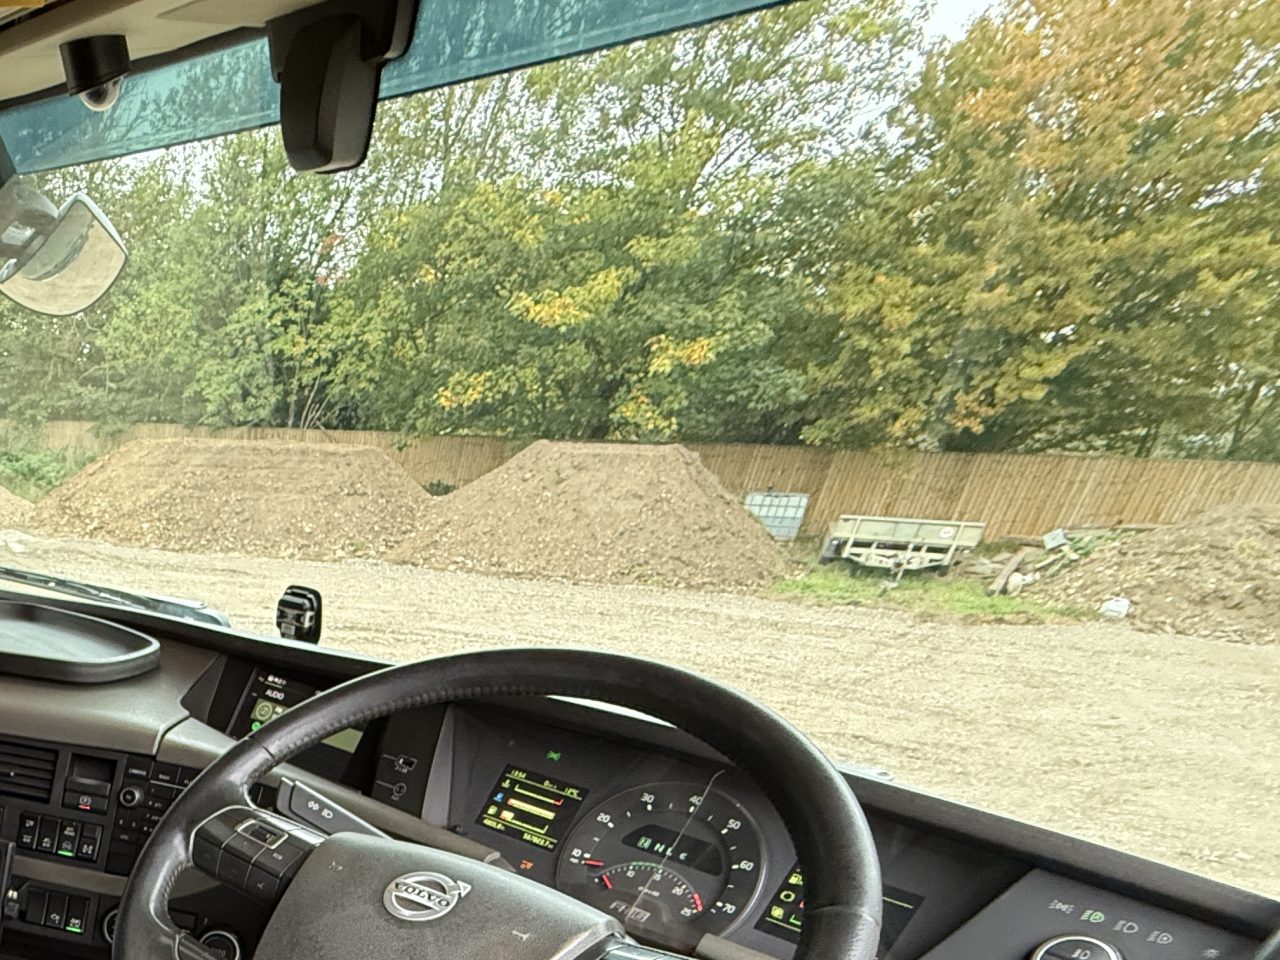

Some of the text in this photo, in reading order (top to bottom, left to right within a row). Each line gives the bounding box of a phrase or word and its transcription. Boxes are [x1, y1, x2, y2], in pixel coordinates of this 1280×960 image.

[265, 688, 285, 701] AUDIO
[641, 792, 654, 803] 30
[689, 795, 704, 806] 40
[596, 812, 611, 823] 20
[727, 819, 742, 830] 50
[571, 848, 582, 857] 10
[739, 860, 755, 871] 60
[626, 870, 636, 879] 10
[395, 881, 450, 907] VOLVO
[672, 886, 684, 896] 20
[680, 907, 692, 917] 25
[722, 902, 736, 914] 70
